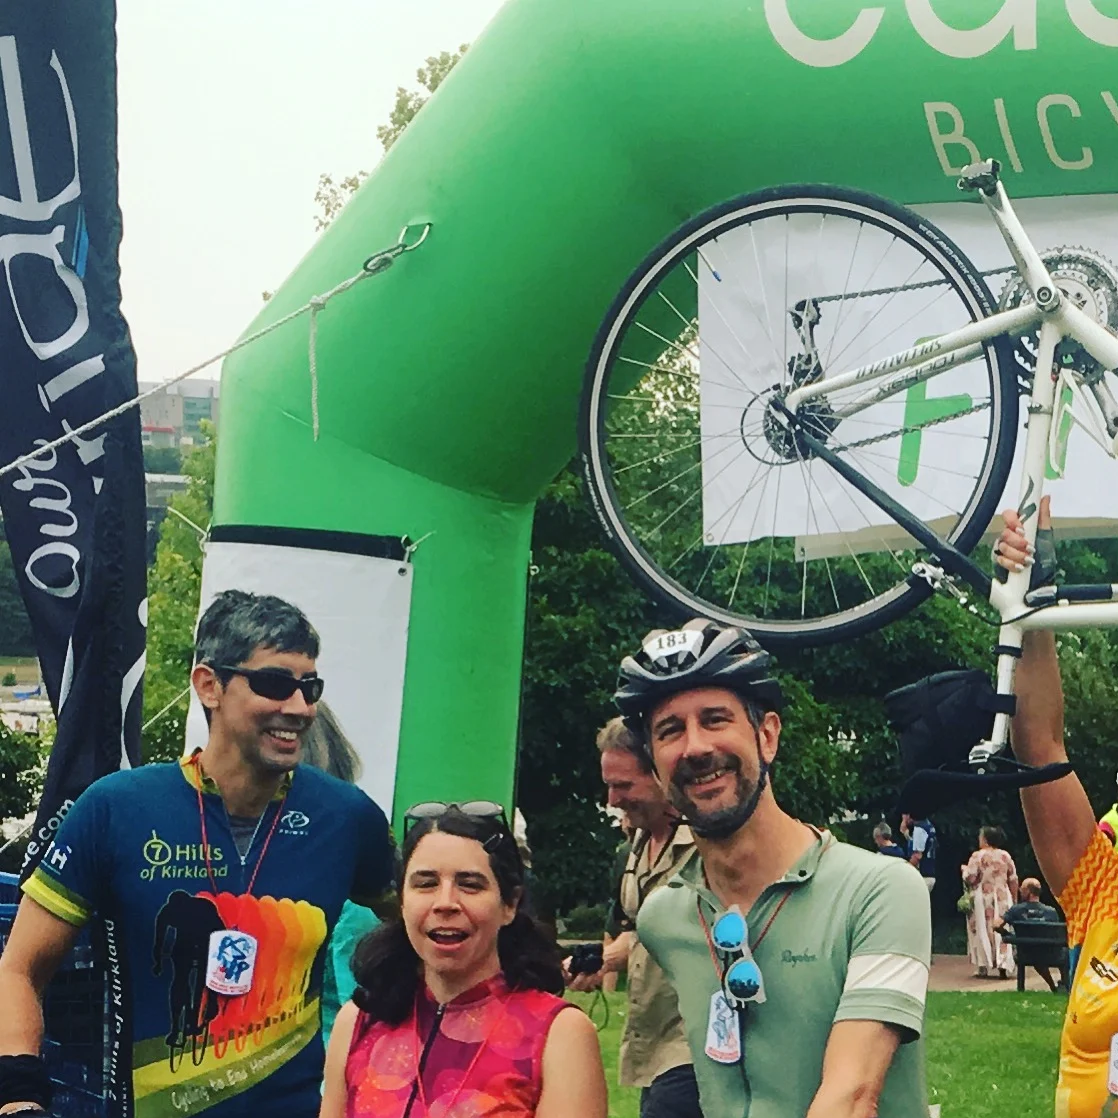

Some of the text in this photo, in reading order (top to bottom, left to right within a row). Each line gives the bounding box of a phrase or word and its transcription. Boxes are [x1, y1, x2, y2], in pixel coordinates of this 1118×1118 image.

[656, 632, 688, 651] 183
[150, 844, 224, 862] 7 Hills
[140, 864, 229, 882] of Kirkland
